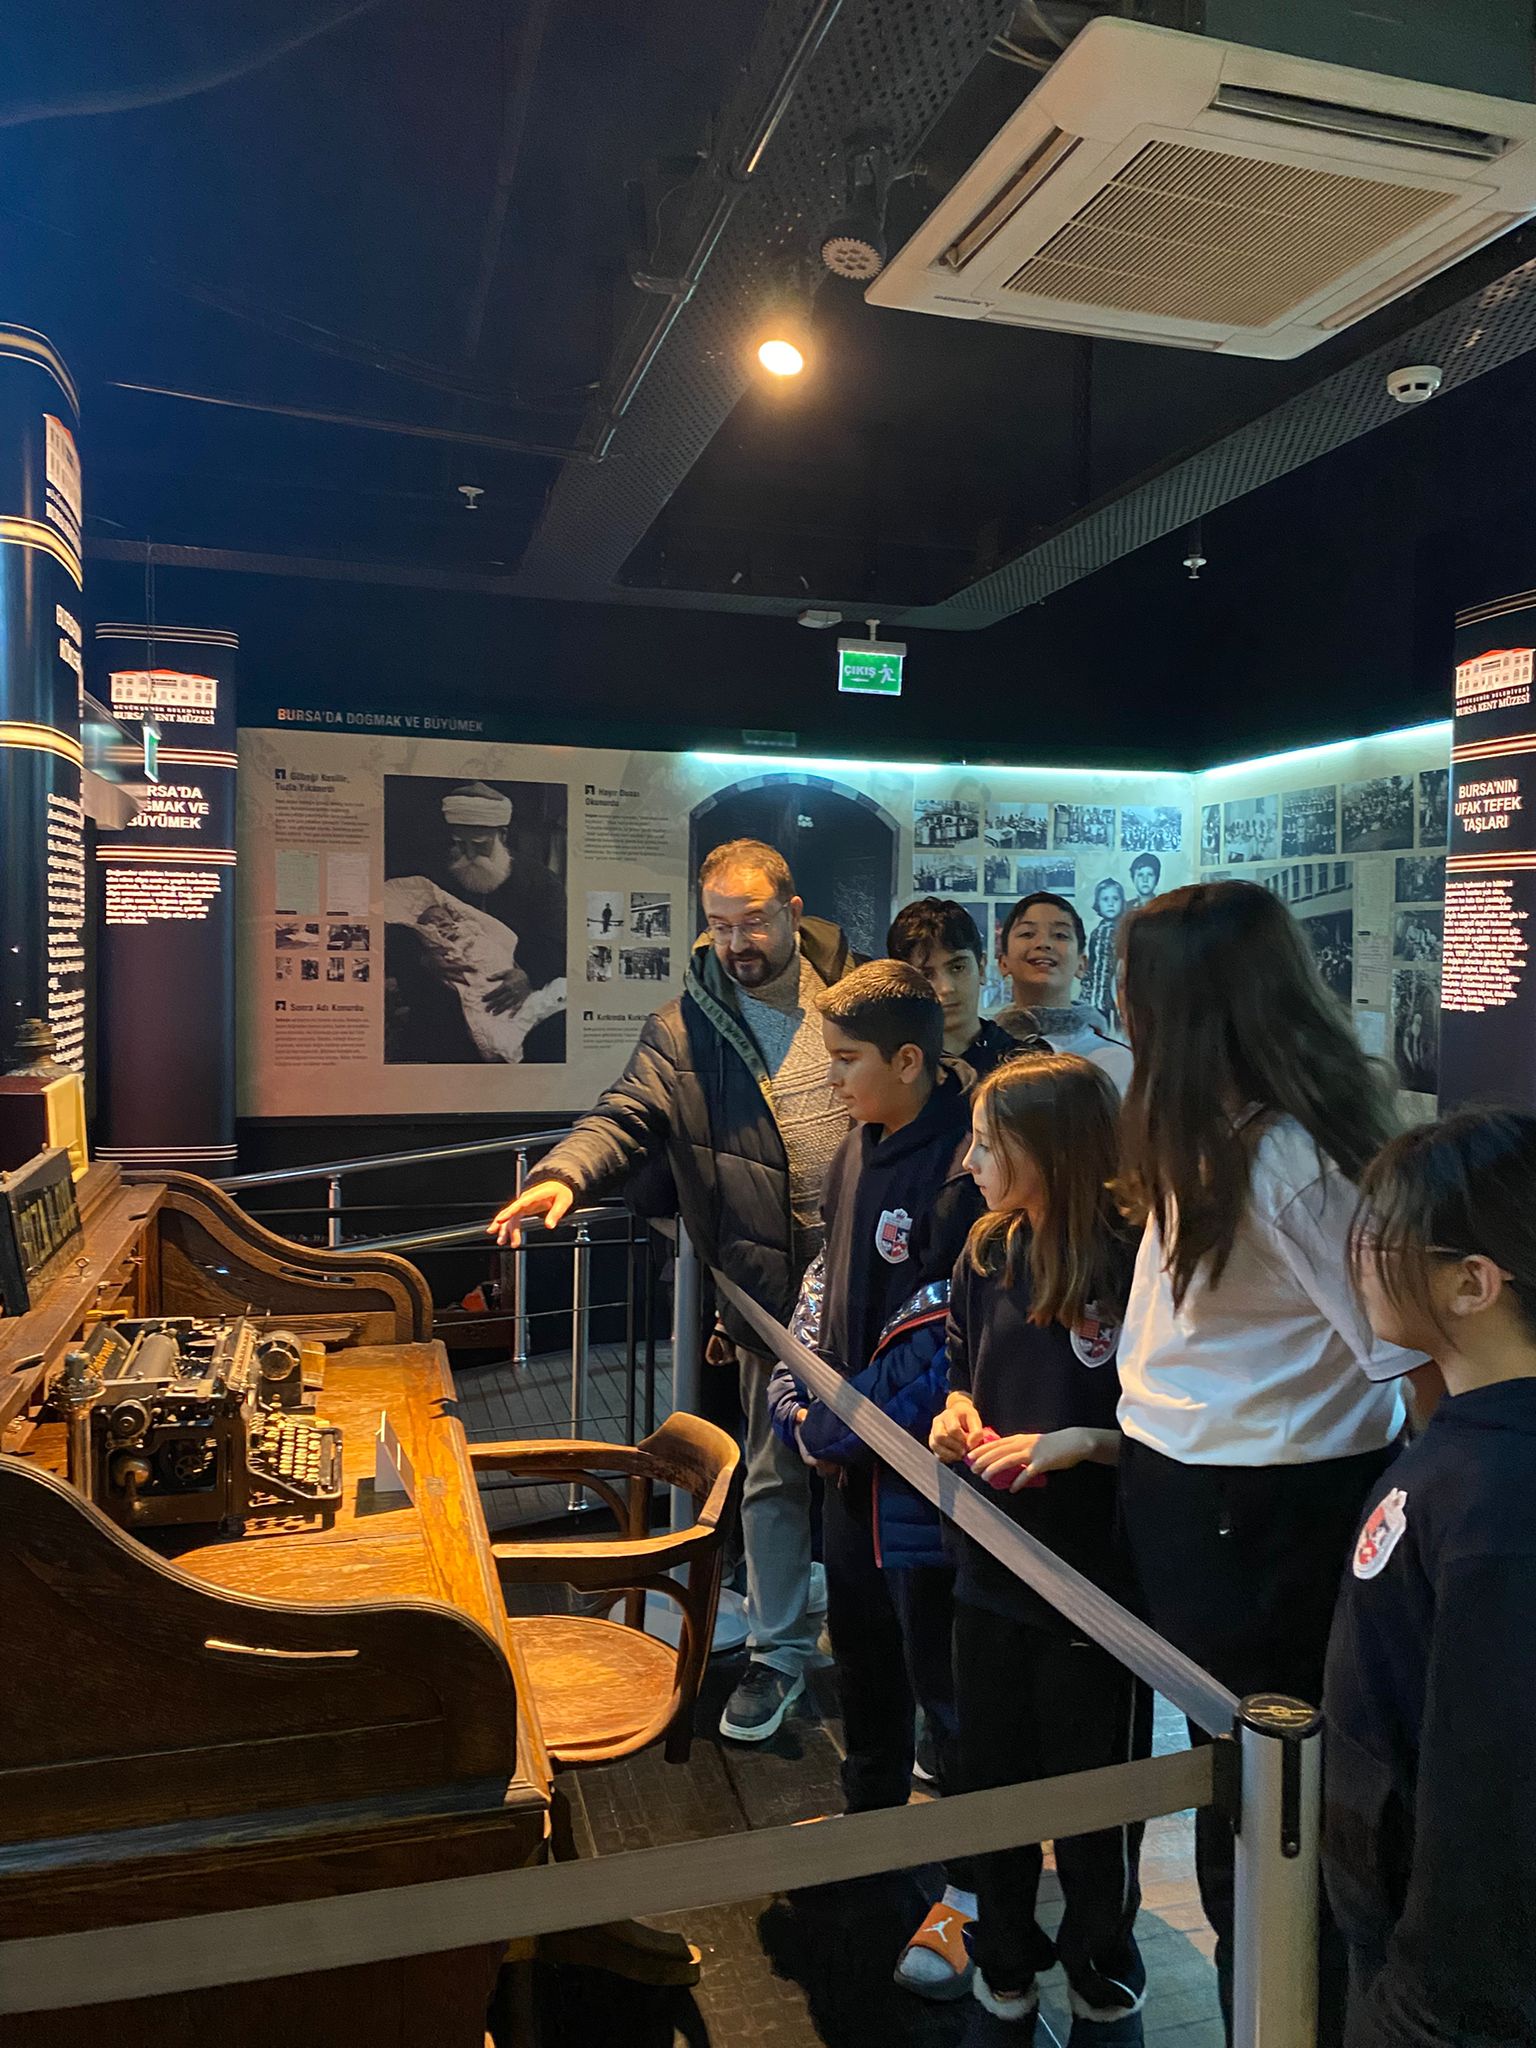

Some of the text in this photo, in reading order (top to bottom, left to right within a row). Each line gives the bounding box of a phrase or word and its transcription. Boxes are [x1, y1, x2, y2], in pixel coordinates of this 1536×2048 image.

[844, 665, 876, 678] ÇIKIŞ
[1456, 692, 1531, 717] BURSA KENT MÜZESİ
[153, 712, 175, 722] ENT
[176, 713, 215, 724] MÜZESİ
[277, 708, 343, 723] BURSA'DA
[404, 715, 420, 728] VE
[147, 785, 203, 799] RSA'DA
[1459, 779, 1518, 798] BURSA'NIN
[187, 802, 210, 815] VE
[1455, 796, 1522, 816] UFAK TEFEK
[1462, 814, 1509, 834] TAŞLARI
